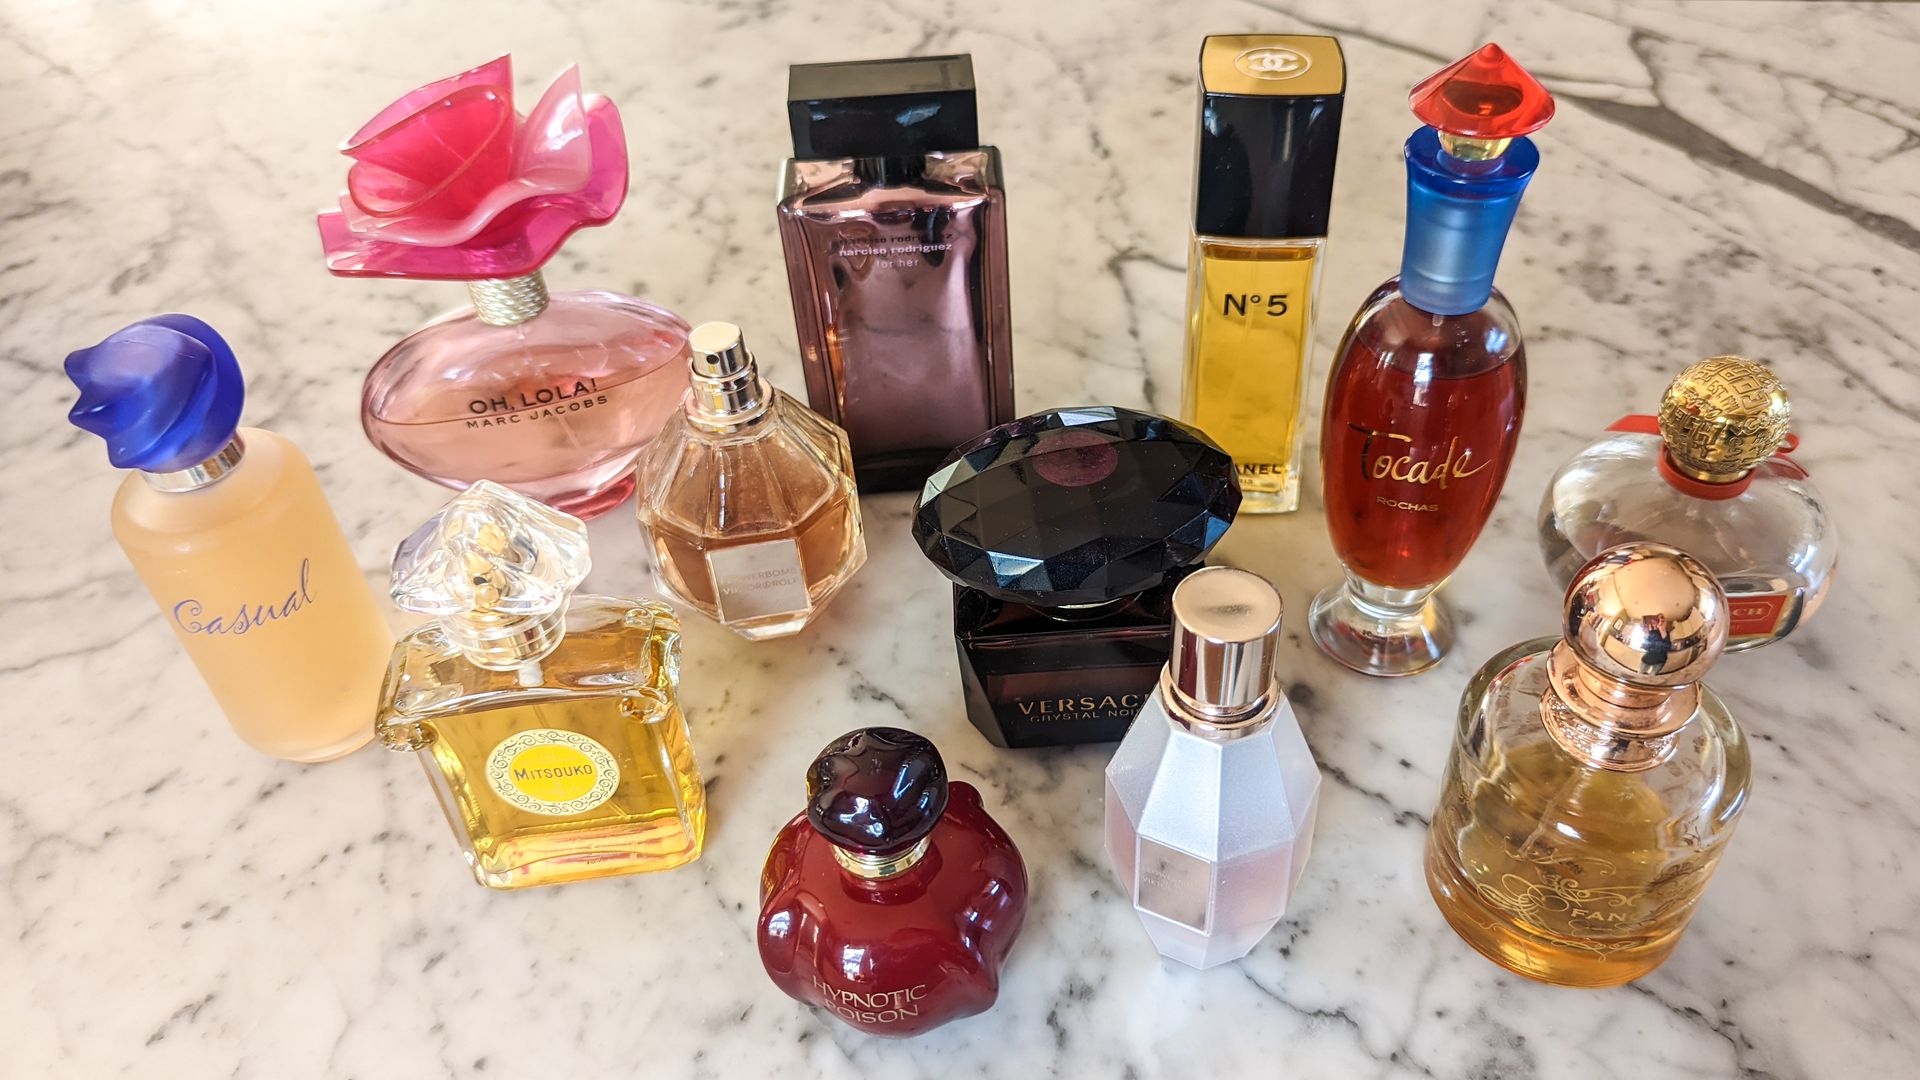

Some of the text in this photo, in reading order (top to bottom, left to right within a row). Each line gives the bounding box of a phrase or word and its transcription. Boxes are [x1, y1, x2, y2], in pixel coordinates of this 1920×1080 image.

[839, 243, 953, 257] narciso rodriguez
[876, 258, 919, 269] for her
[469, 378, 598, 415] OH, LOLA!
[467, 395, 608, 430] MARC JACOBS
[1347, 422, 1493, 490] Tocade
[1376, 496, 1439, 512] ROCHAS
[173, 557, 314, 635] Casual
[1030, 711, 1100, 723] CRYSTAL
[513, 764, 593, 782] MITSOUKO
[813, 975, 928, 1010] HYPNOTIC
[824, 998, 919, 1023] POISON
